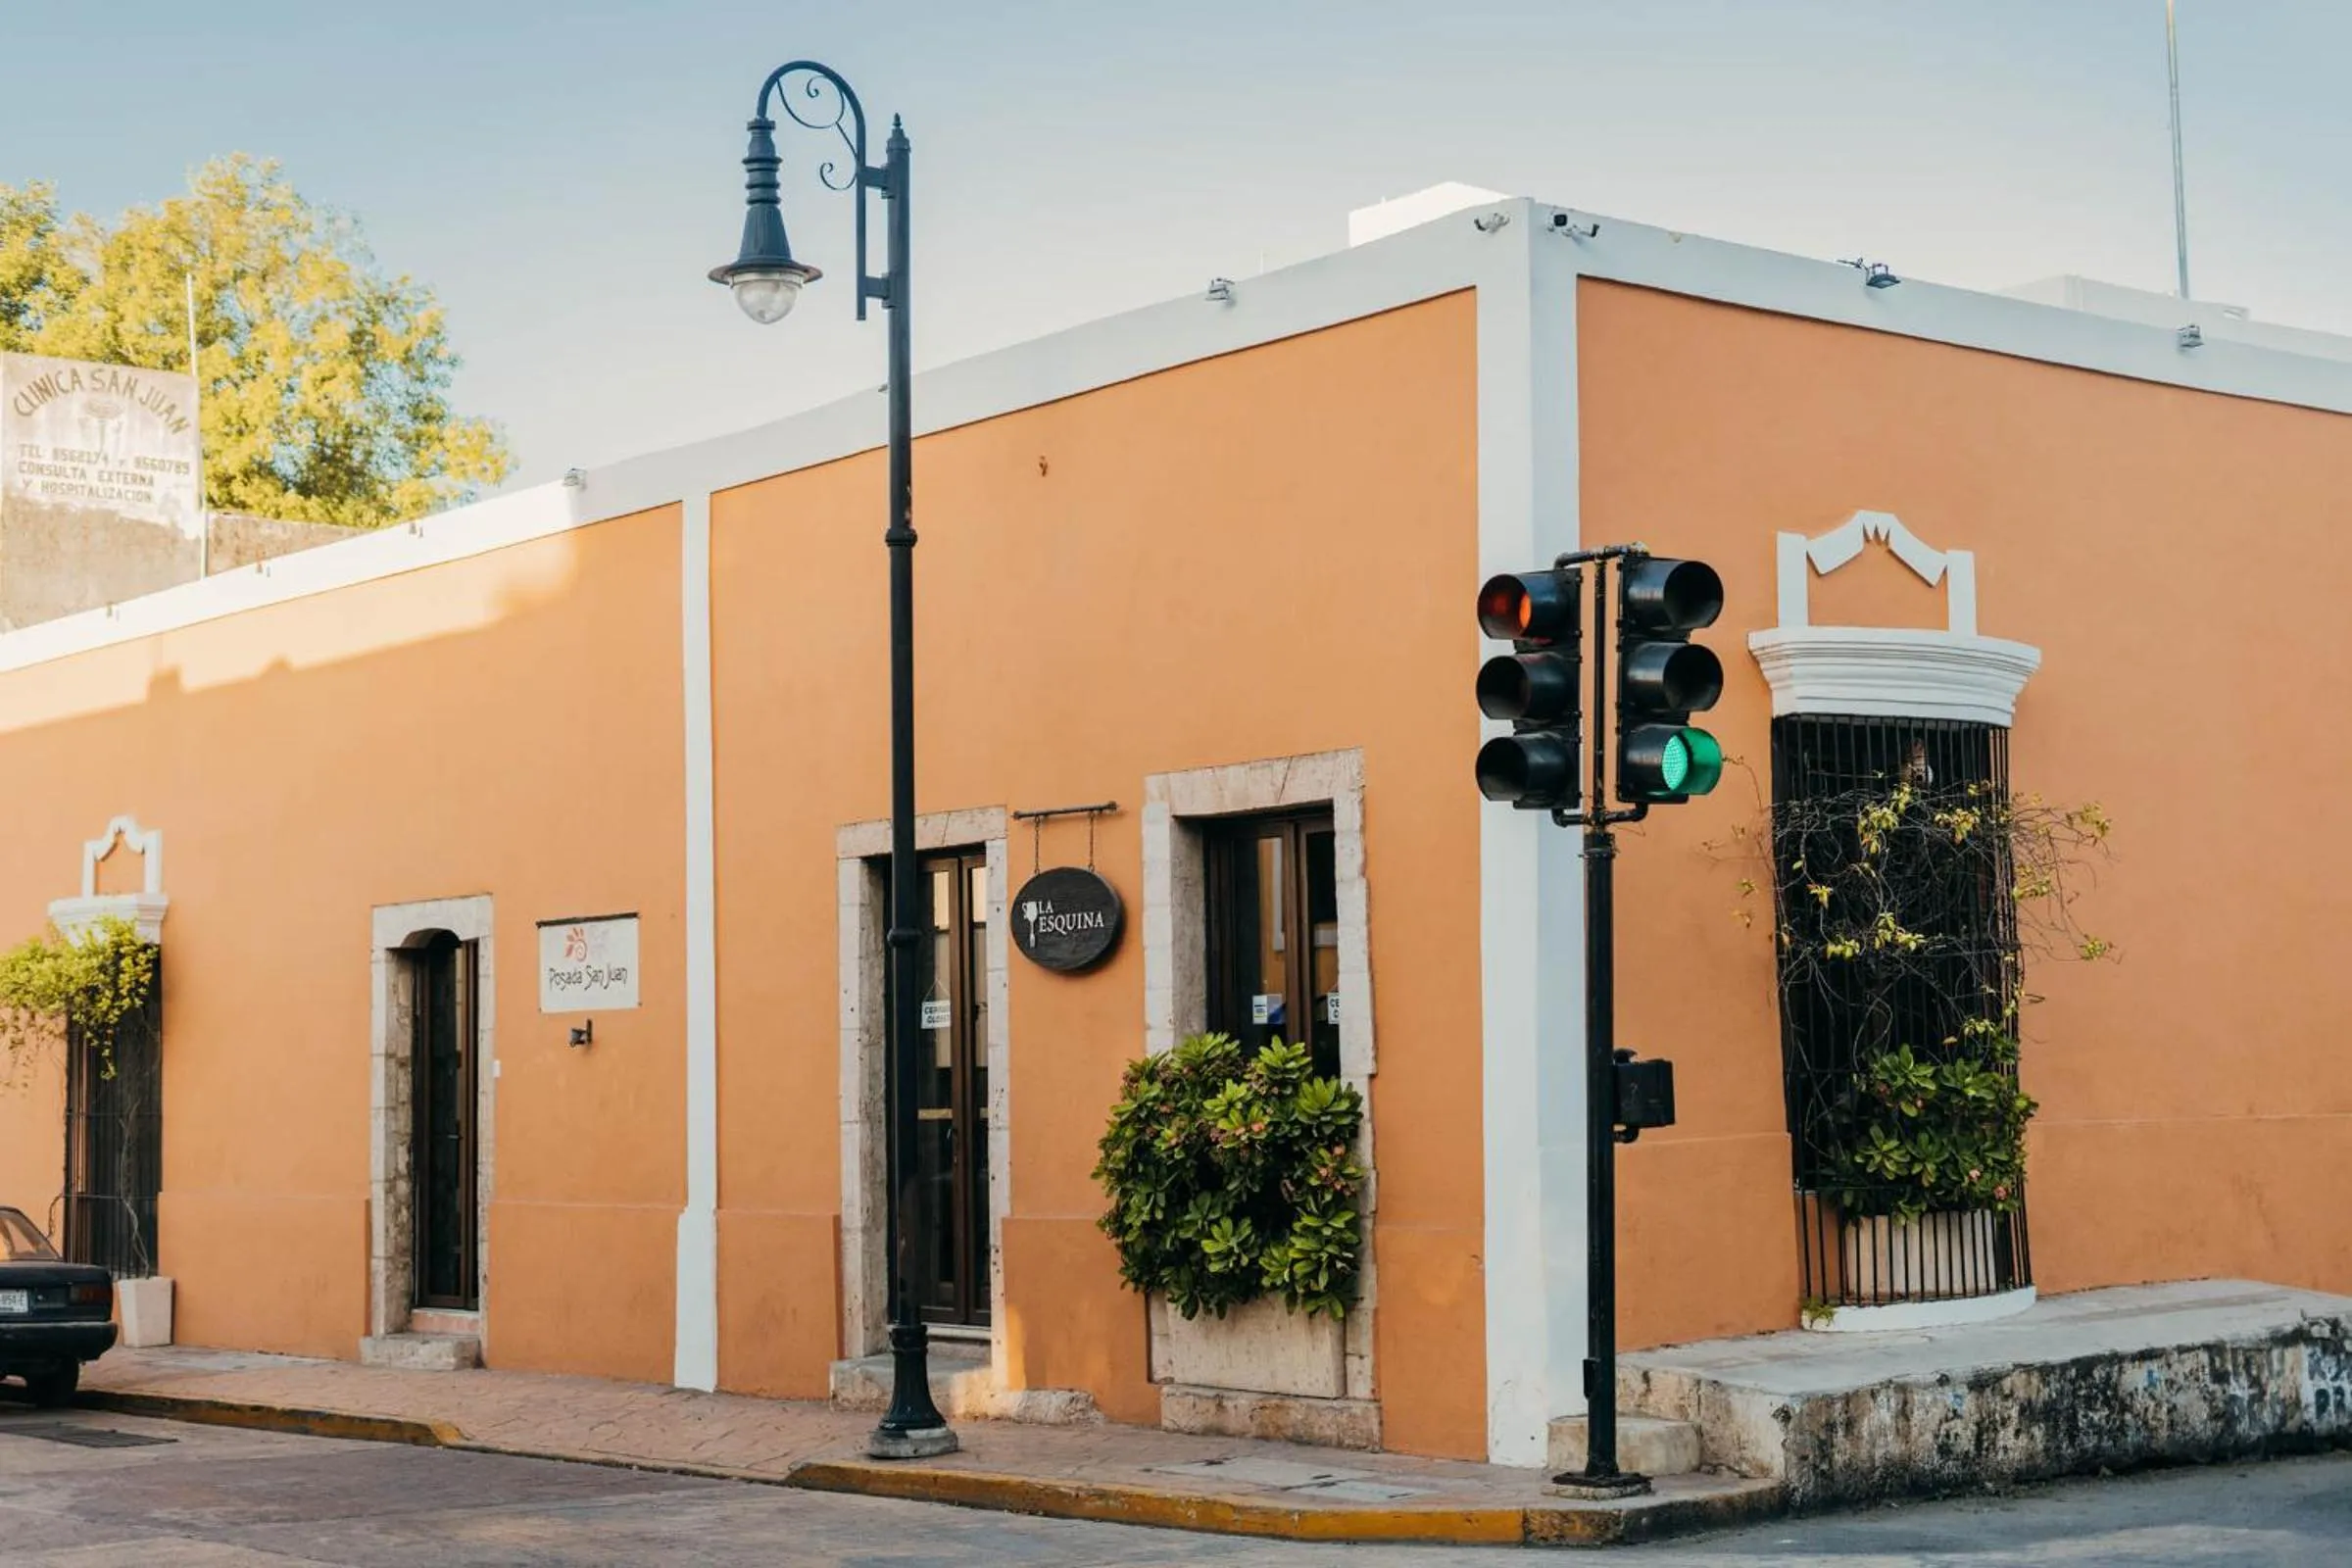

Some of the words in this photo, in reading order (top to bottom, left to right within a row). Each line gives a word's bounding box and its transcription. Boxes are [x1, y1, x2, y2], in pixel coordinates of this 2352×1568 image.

[14, 368, 84, 416] CLINICA
[90, 368, 138, 399] SAN
[139, 386, 190, 434] JUAN
[18, 461, 87, 480] CONSULTA
[98, 469, 154, 488] EXTERNA
[41, 481, 152, 503] HOSPITALIZACION
[1039, 900, 1054, 914] LA
[1039, 910, 1104, 935] ESQUINA
[549, 966, 582, 991] Posada
[584, 964, 604, 991] San
[603, 962, 627, 990] Juan
